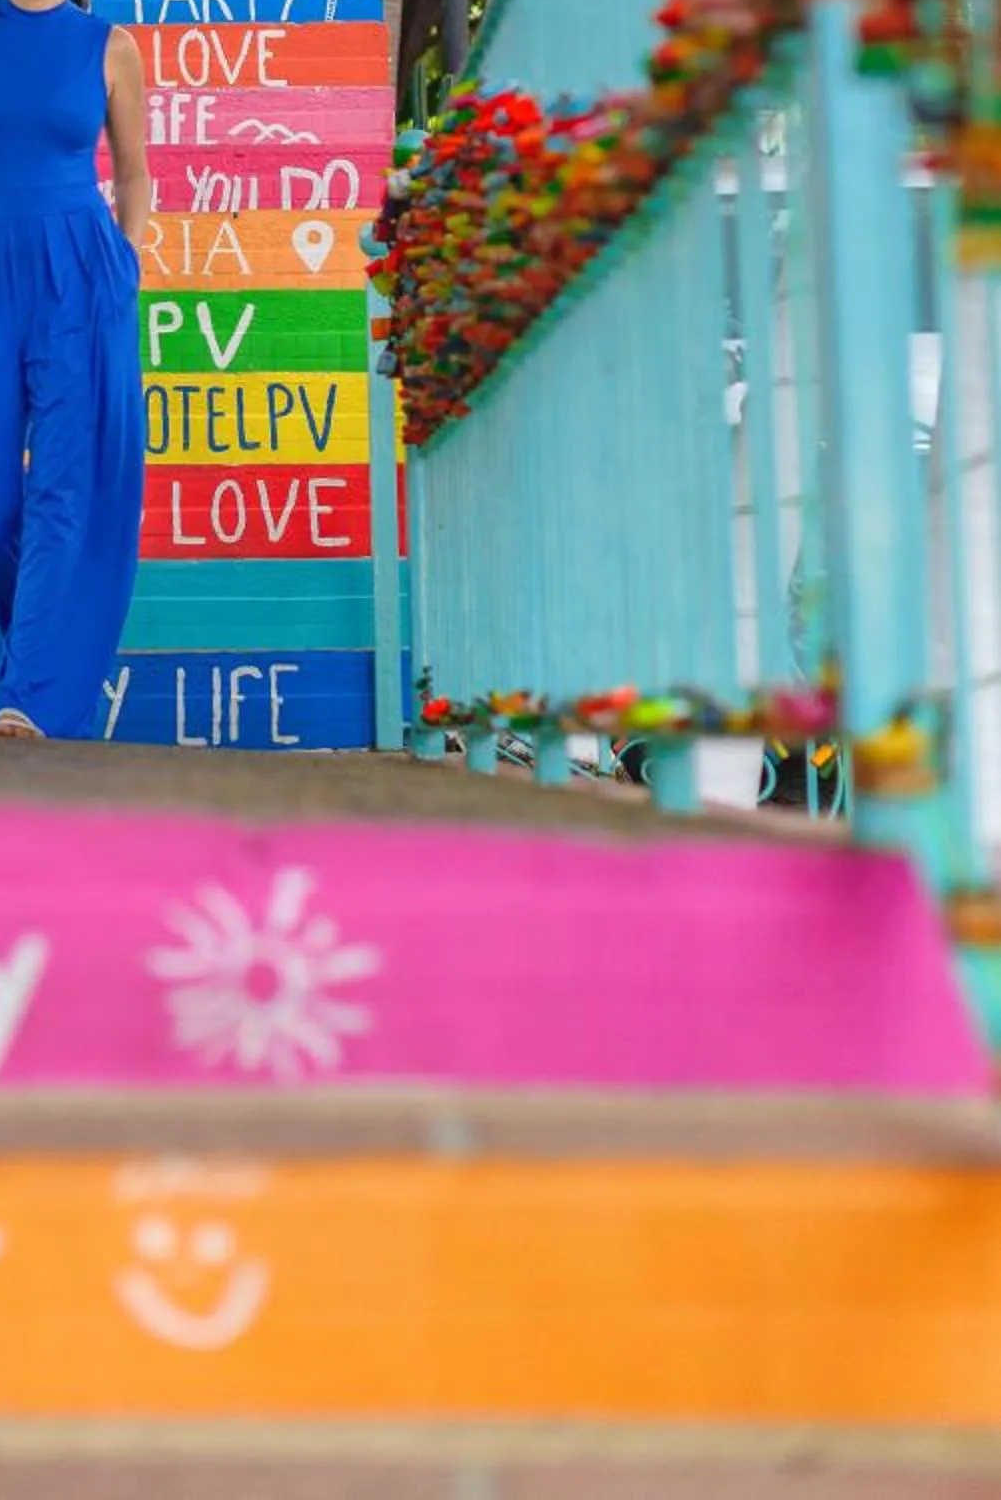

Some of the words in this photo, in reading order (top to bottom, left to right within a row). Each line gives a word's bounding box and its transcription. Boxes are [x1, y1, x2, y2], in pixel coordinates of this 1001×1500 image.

[152, 27, 288, 88] LOVE
[280, 158, 361, 211] DO
[148, 300, 256, 370] PV
[171, 477, 352, 547] LOVE
[176, 663, 300, 746] LIFE
